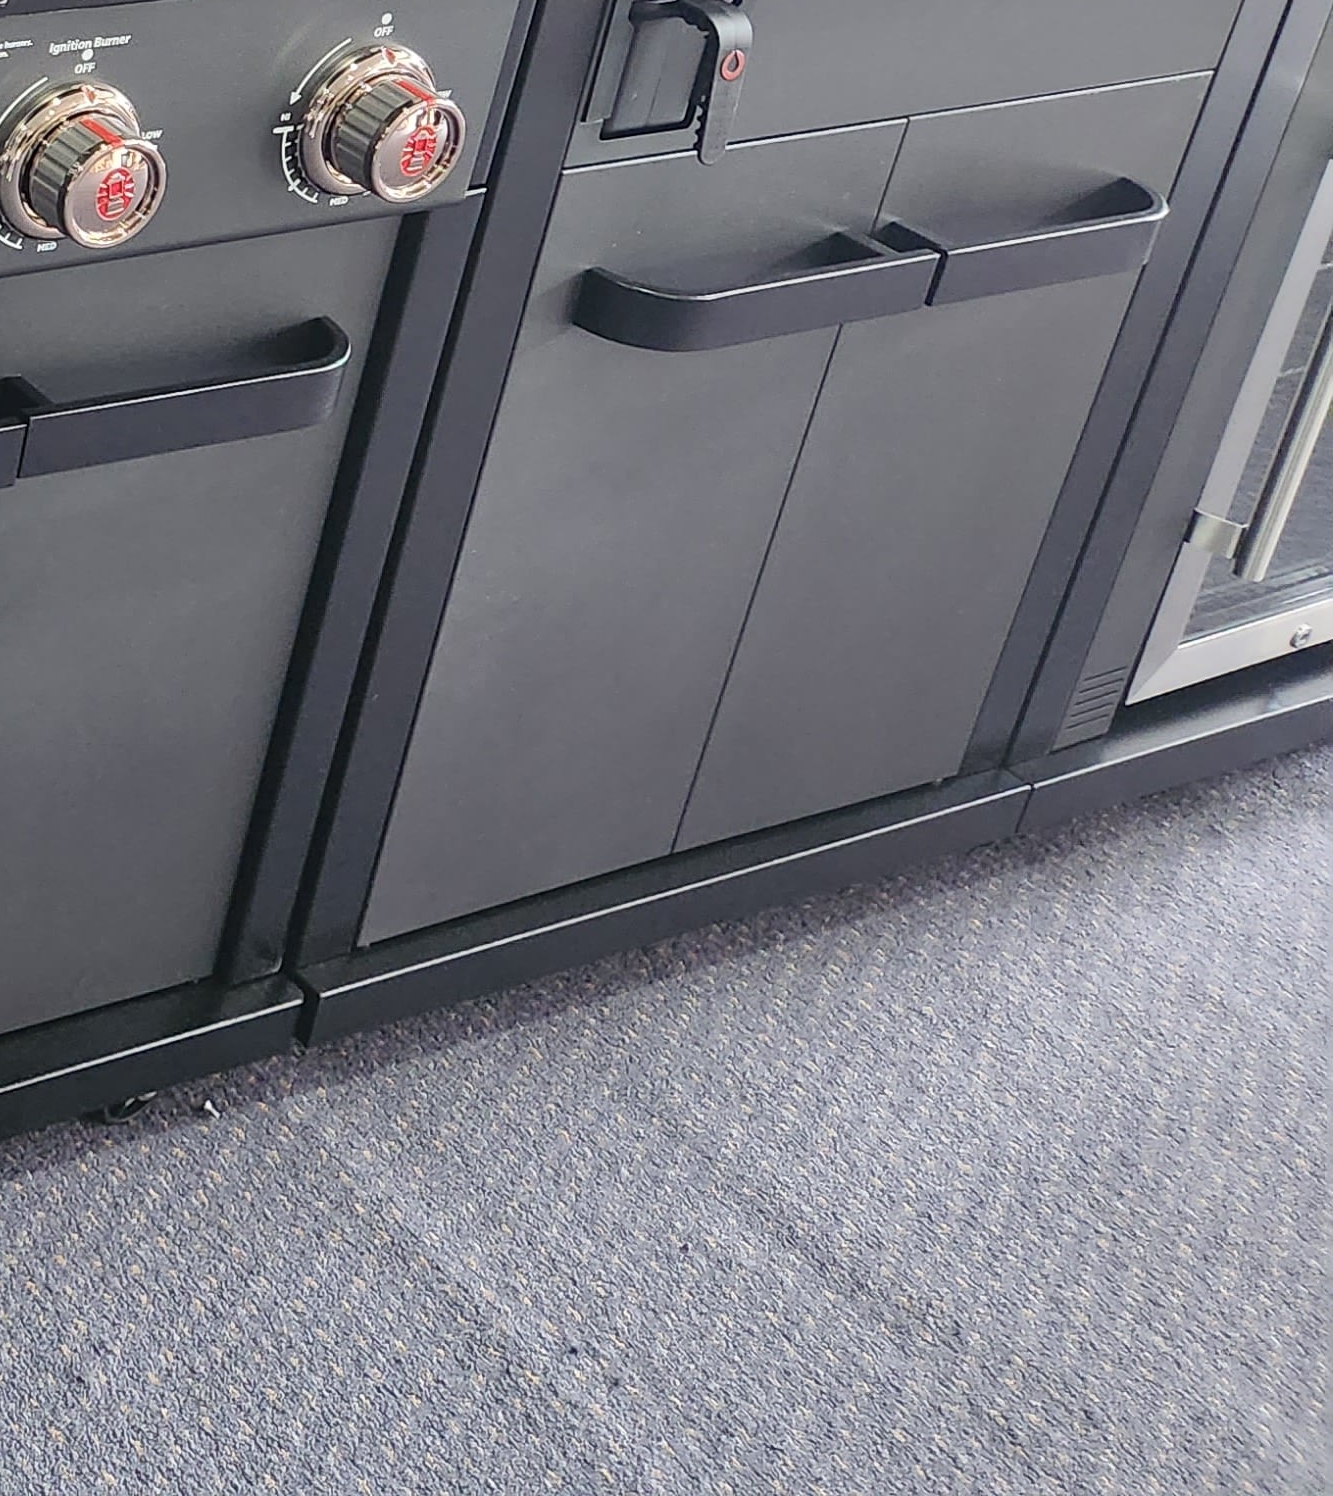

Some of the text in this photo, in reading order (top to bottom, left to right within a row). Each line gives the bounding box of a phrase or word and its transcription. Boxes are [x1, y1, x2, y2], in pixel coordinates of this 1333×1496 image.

[374, 25, 394, 38] OFF
[49, 34, 131, 56] Ignition Burner
[74, 62, 96, 74] OFF
